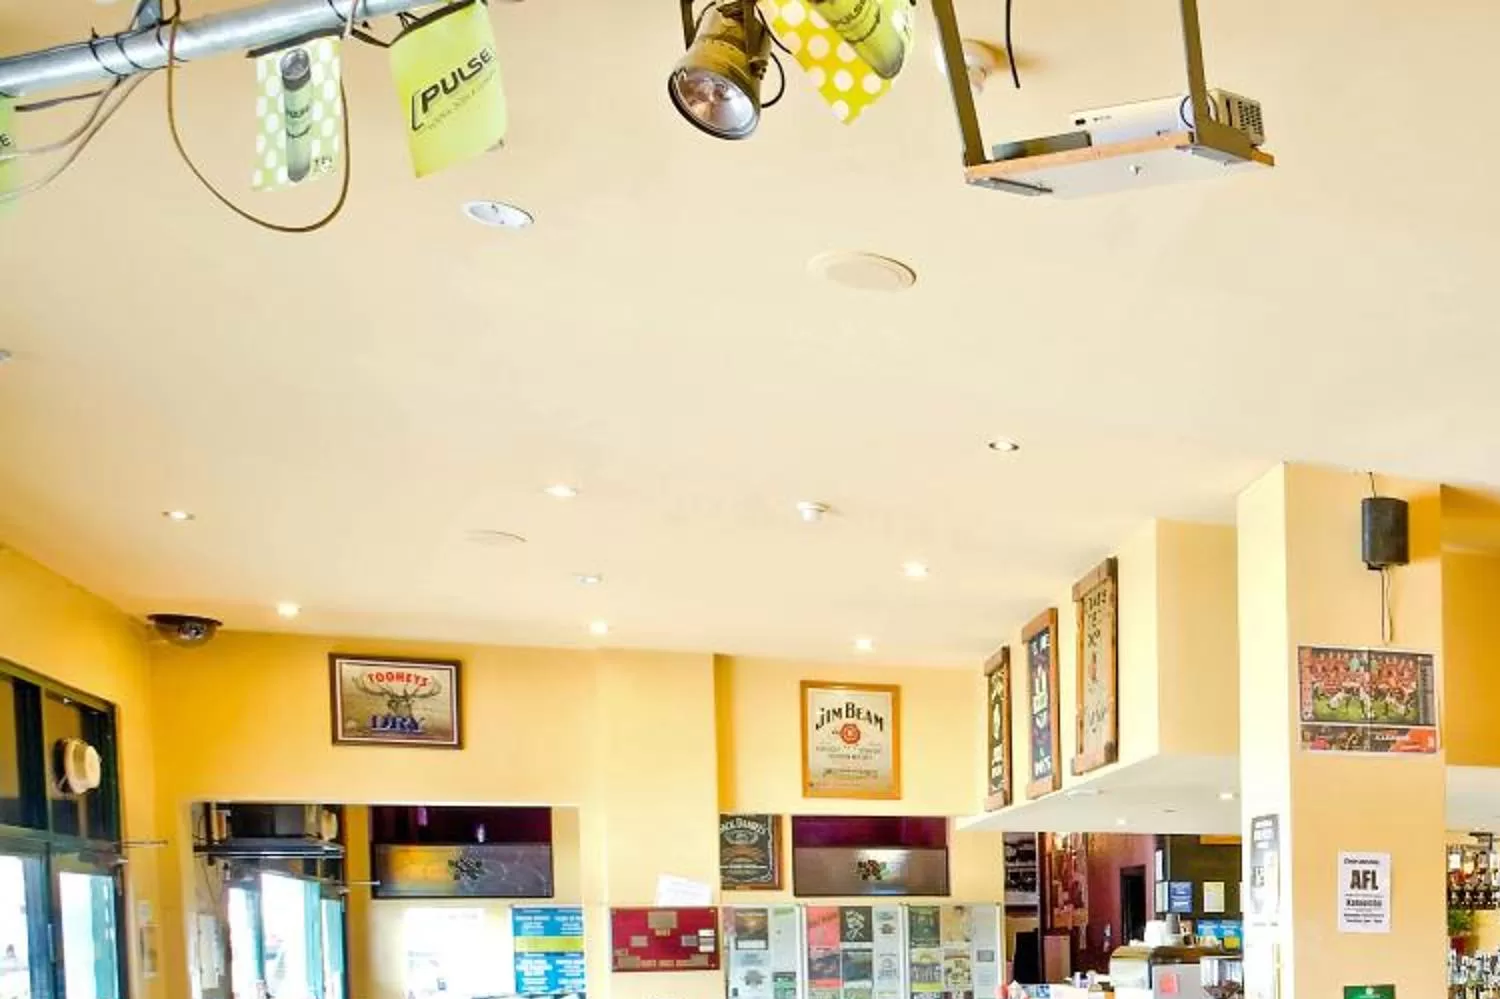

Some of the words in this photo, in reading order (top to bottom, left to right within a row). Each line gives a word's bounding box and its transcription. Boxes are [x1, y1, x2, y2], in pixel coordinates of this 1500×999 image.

[421, 48, 492, 113] PULSE
[367, 671, 430, 687] TOOHEYS
[815, 706, 843, 731] JIM
[844, 701, 884, 733] BEAM
[1350, 869, 1379, 890] AFL
